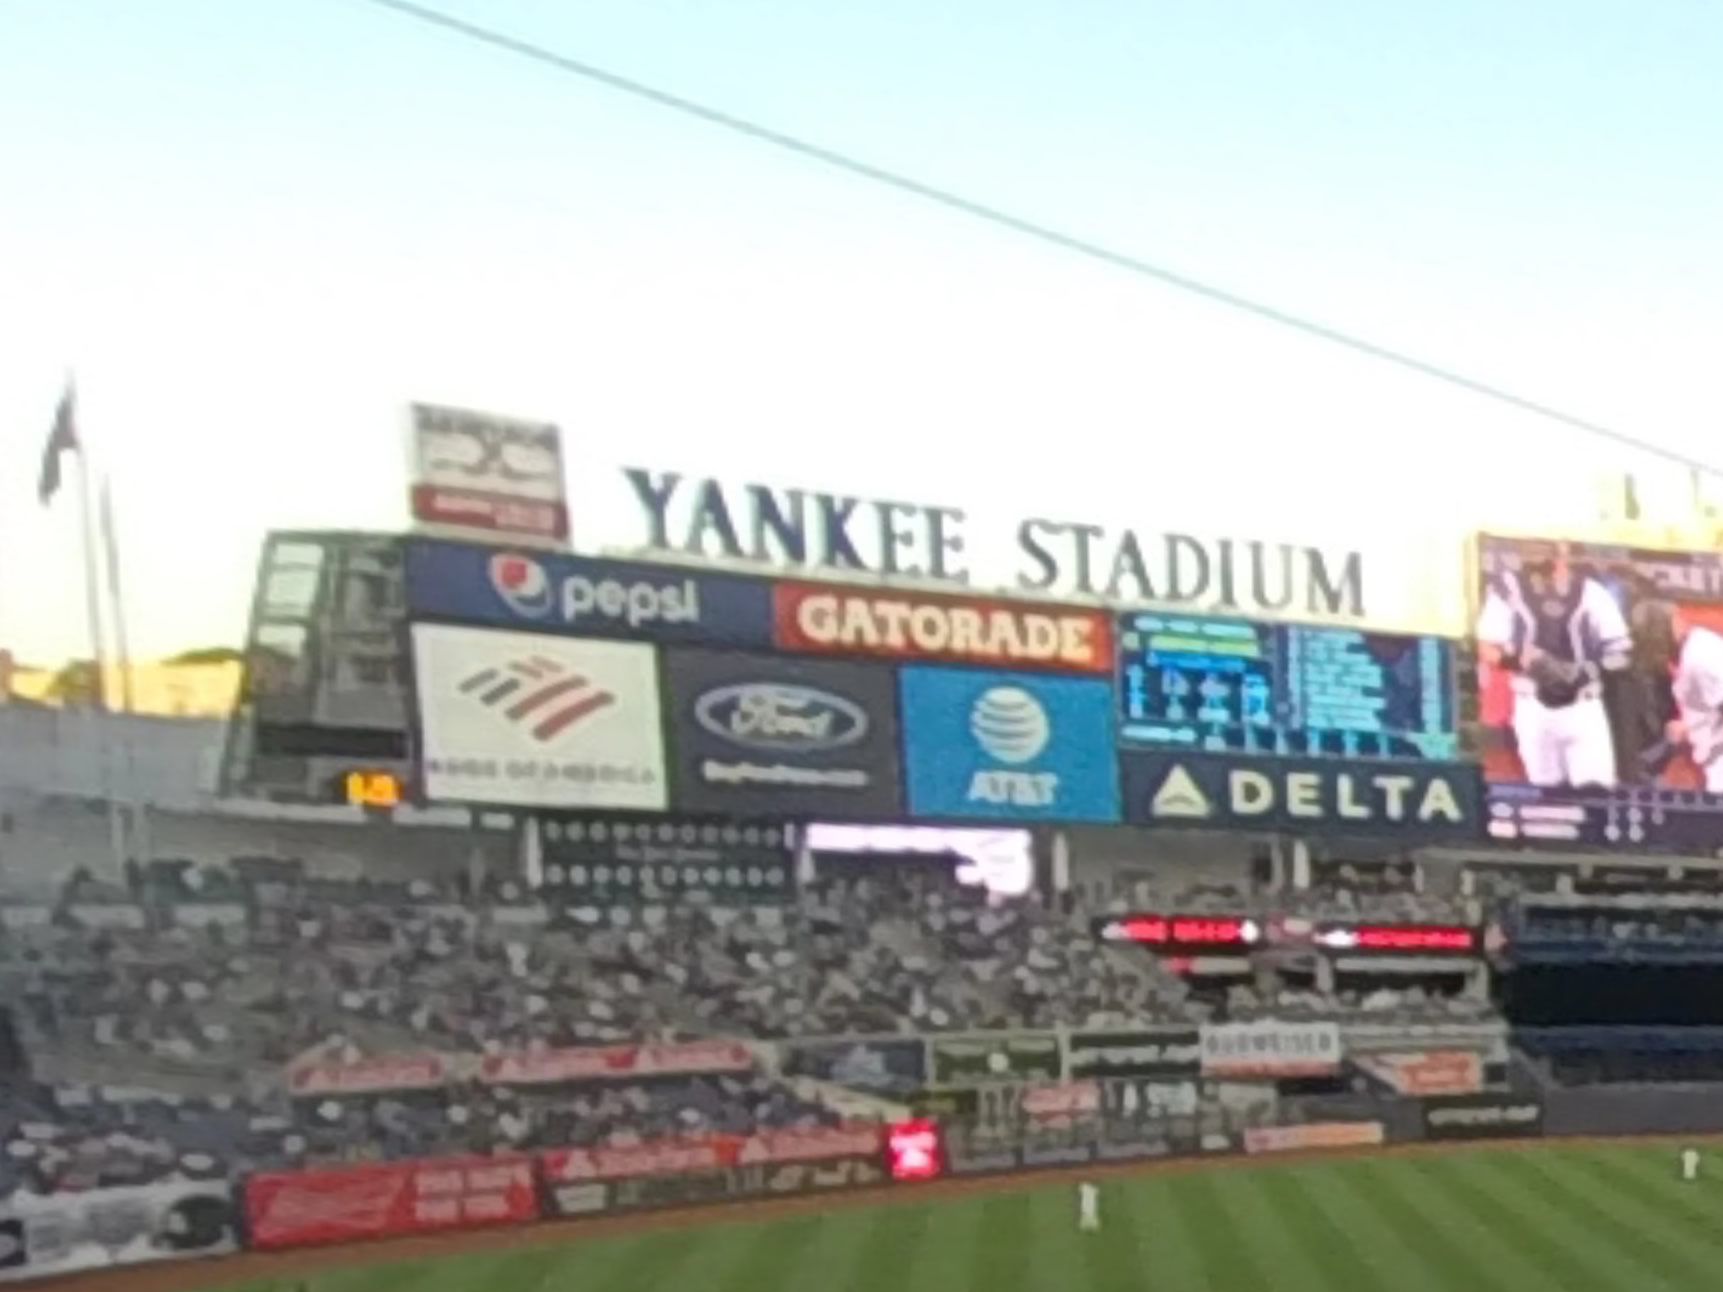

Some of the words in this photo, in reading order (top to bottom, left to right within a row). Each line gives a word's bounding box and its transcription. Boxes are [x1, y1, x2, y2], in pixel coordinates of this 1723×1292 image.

[621, 467, 969, 582] YANKEE
[1016, 516, 1366, 618] STADIUM
[563, 575, 698, 627] pepsi
[797, 596, 1094, 655] GATORADE
[967, 770, 1060, 808] AT&T
[1230, 769, 1462, 823] DELTA
